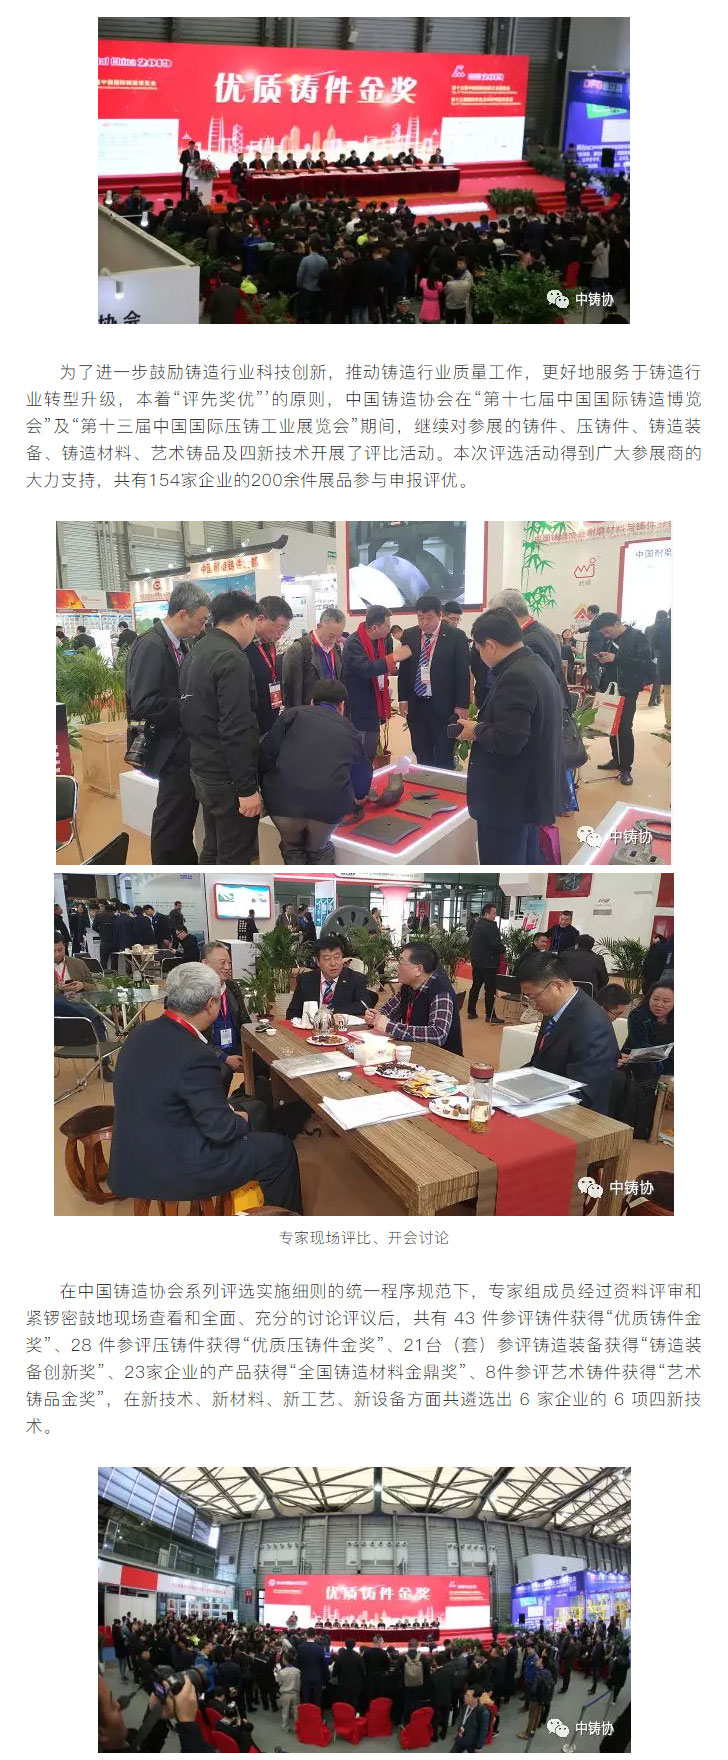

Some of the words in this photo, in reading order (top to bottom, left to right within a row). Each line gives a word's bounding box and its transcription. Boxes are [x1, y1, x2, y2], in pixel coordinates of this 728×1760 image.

[214, 72, 418, 104] 优质铸件金奖
[325, 1585, 431, 1601] 优质铸件金奖
